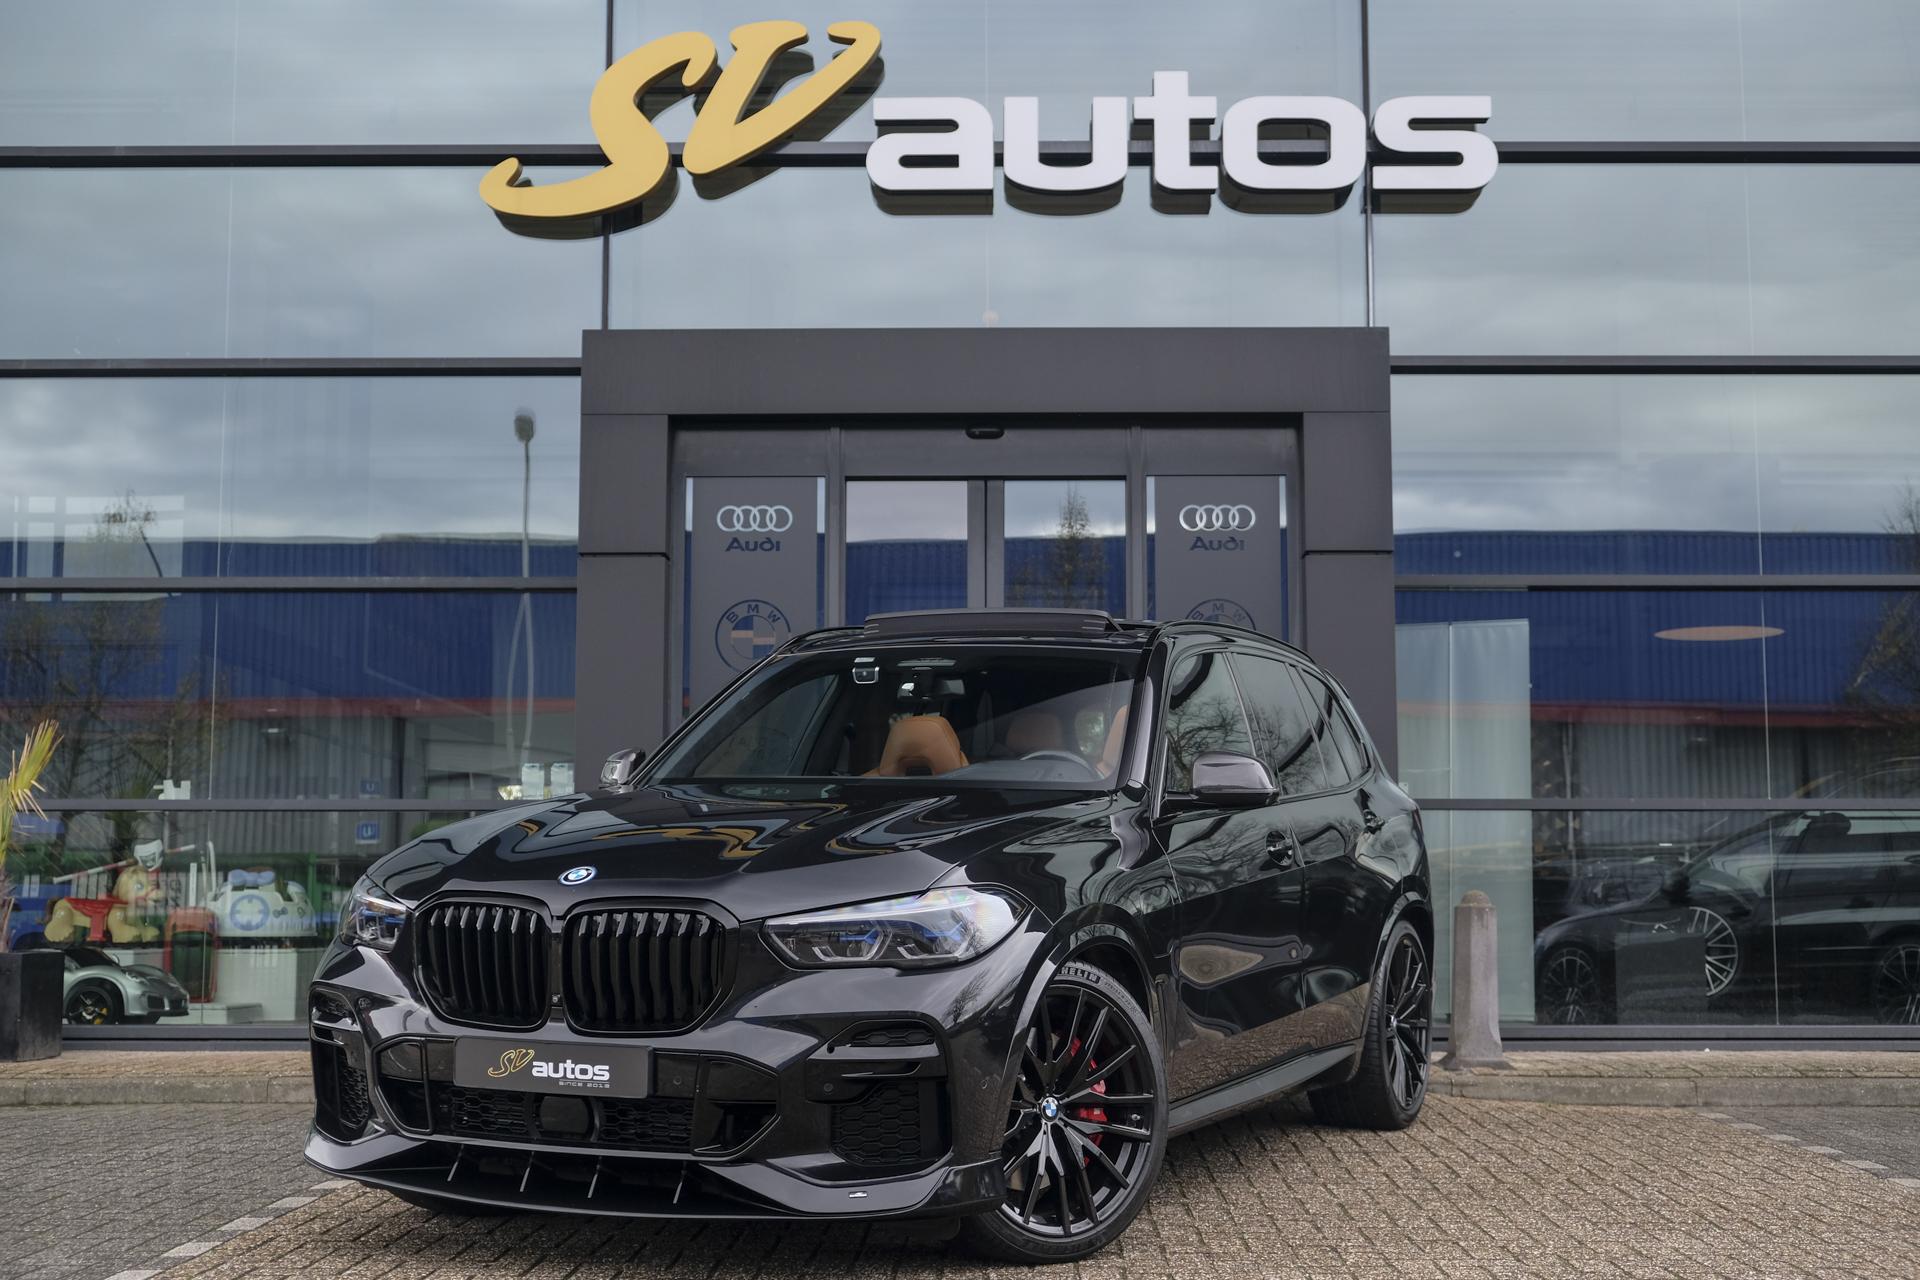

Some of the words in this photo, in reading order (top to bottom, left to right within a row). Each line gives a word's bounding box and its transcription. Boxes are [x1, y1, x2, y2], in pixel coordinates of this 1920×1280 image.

[478, 20, 881, 218] SV
[865, 70, 1498, 191] autos
[725, 536, 780, 552] Audi
[1190, 536, 1245, 551] Audi
[725, 603, 781, 624] BMW
[1191, 603, 1246, 622] BMW
[1061, 967, 1097, 982] HELIN
[531, 1059, 610, 1081] autos
